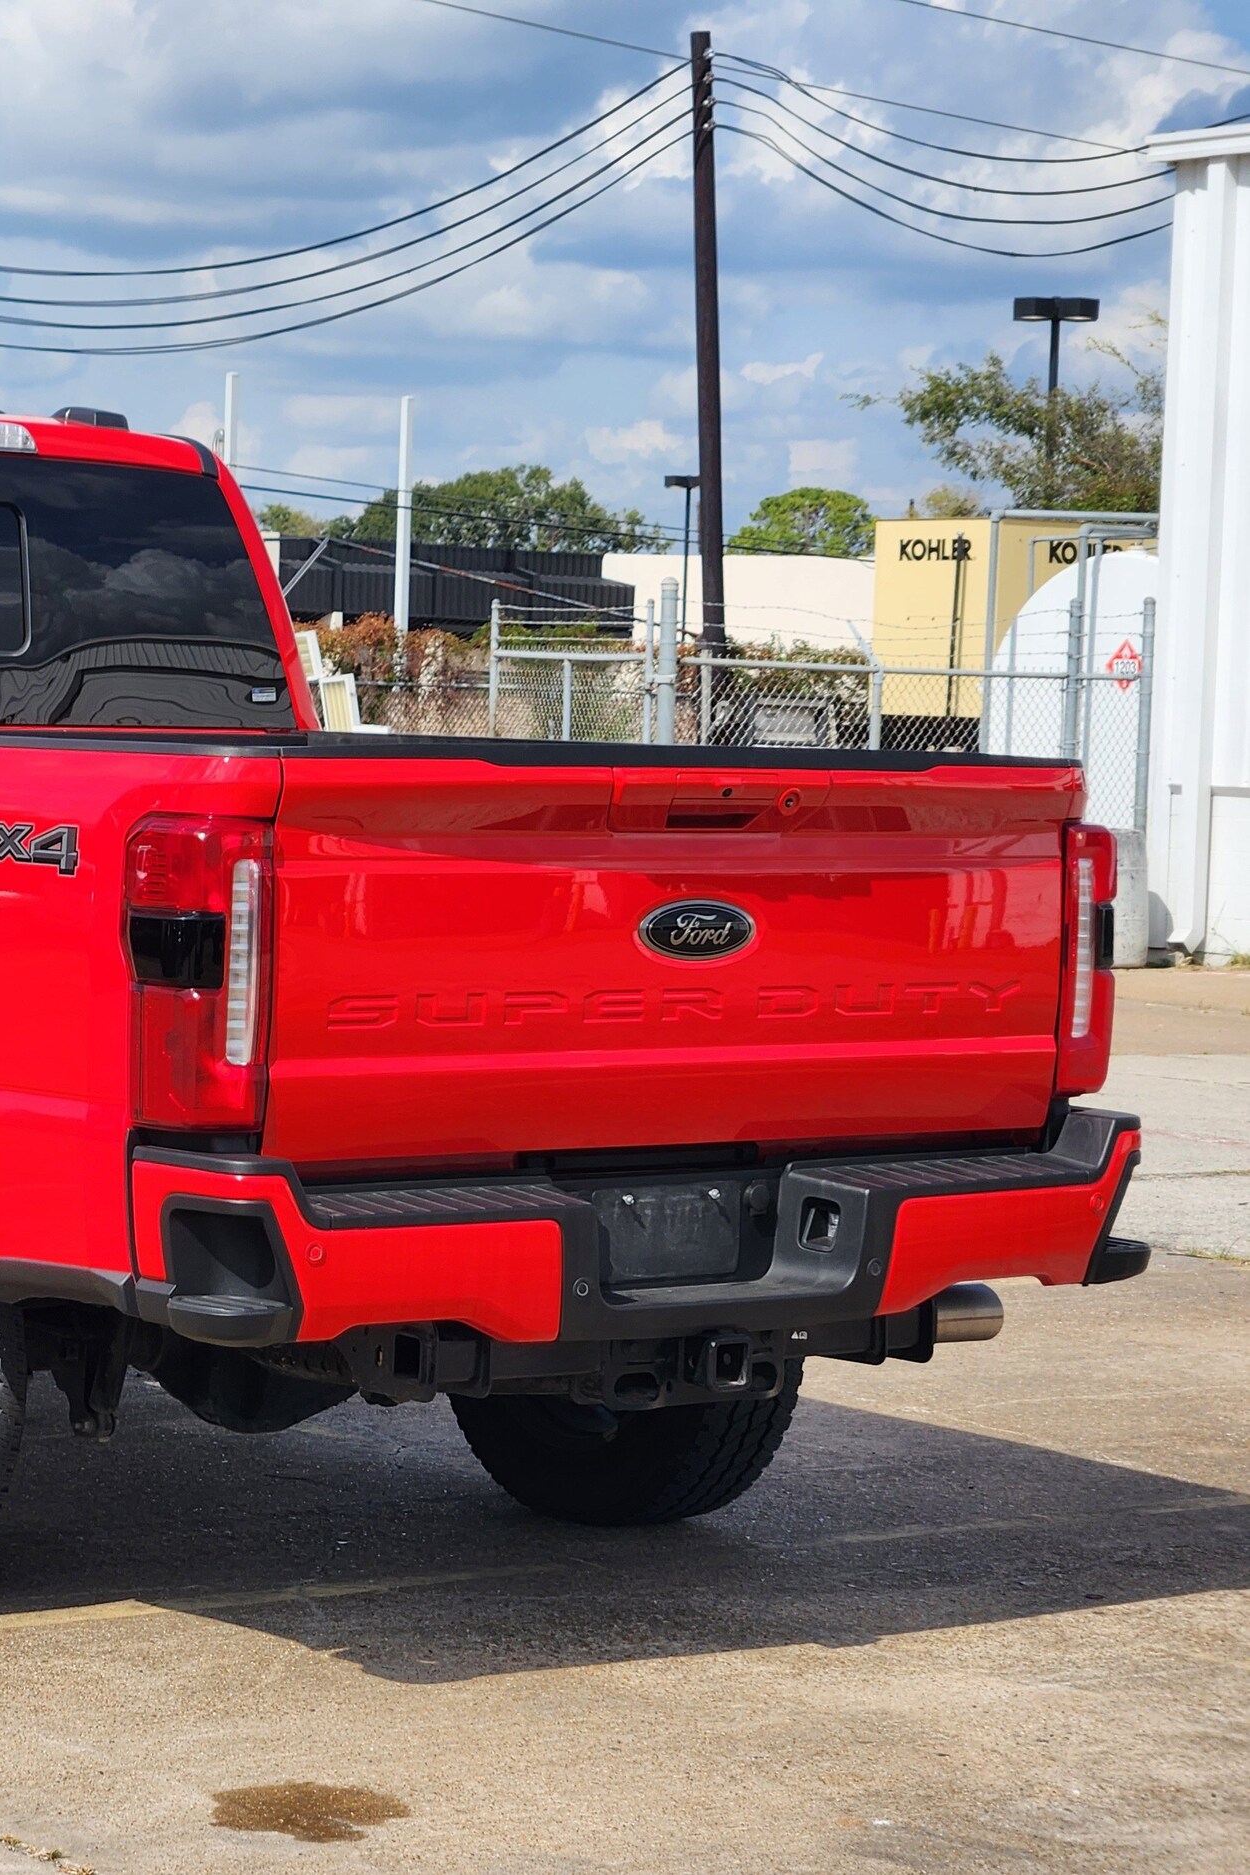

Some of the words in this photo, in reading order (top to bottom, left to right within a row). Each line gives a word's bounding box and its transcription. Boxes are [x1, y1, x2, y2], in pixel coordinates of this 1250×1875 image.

[899, 539, 972, 560] KOHLER
[1115, 661, 1136, 674] 1203
[670, 913, 732, 945] Ford
[327, 987, 724, 1030] SUPER
[757, 980, 1021, 1018] DUTY
